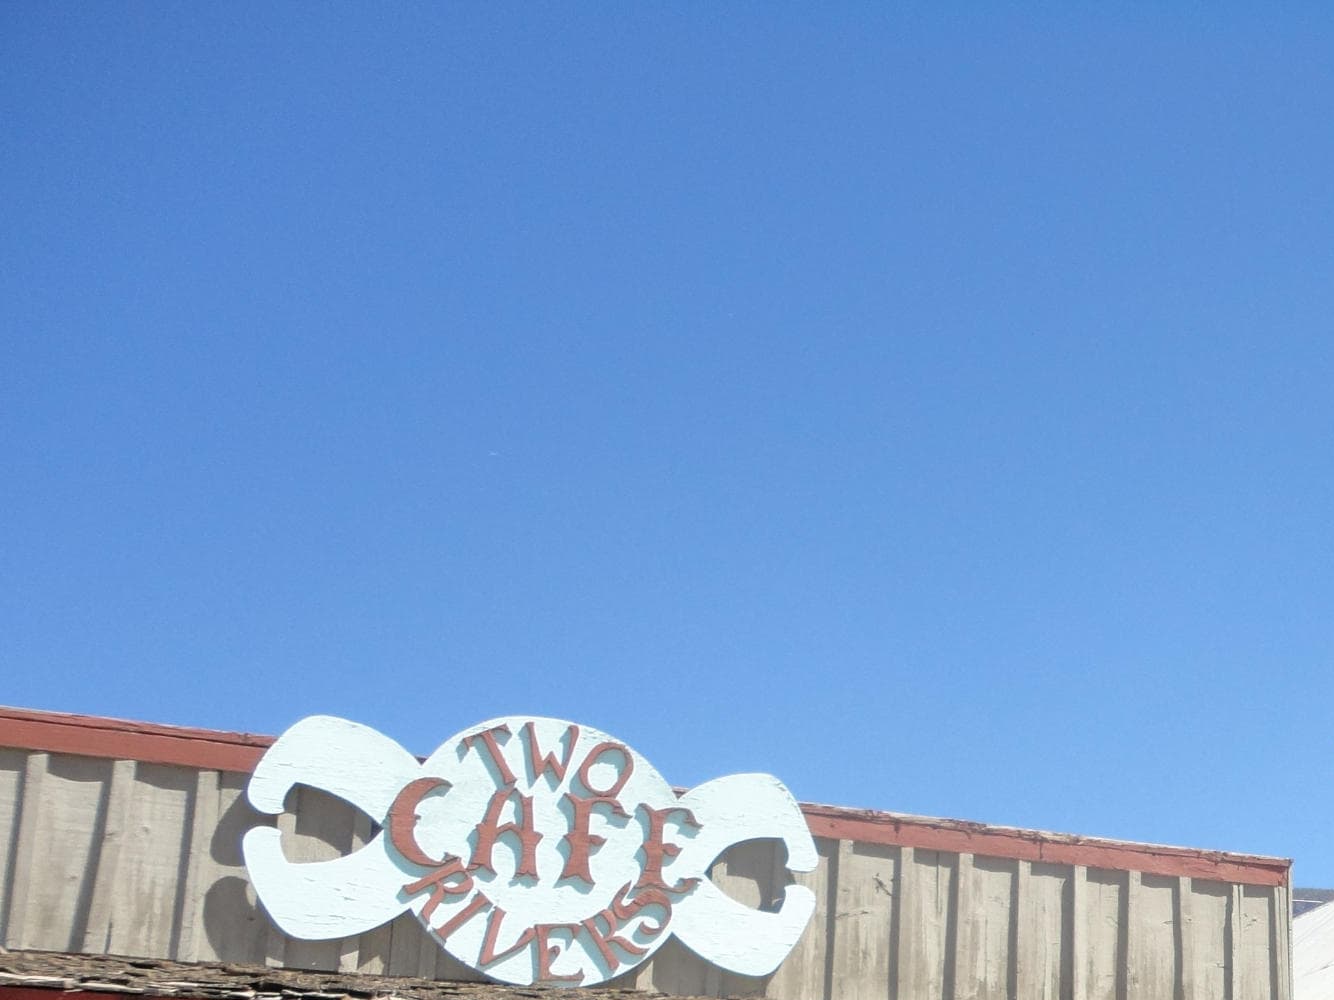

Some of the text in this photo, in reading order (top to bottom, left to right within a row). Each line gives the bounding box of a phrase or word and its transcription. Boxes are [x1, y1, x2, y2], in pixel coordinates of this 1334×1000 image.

[462, 721, 634, 799] TWO
[387, 776, 704, 893] CAFE
[402, 856, 673, 983] RIVERS
